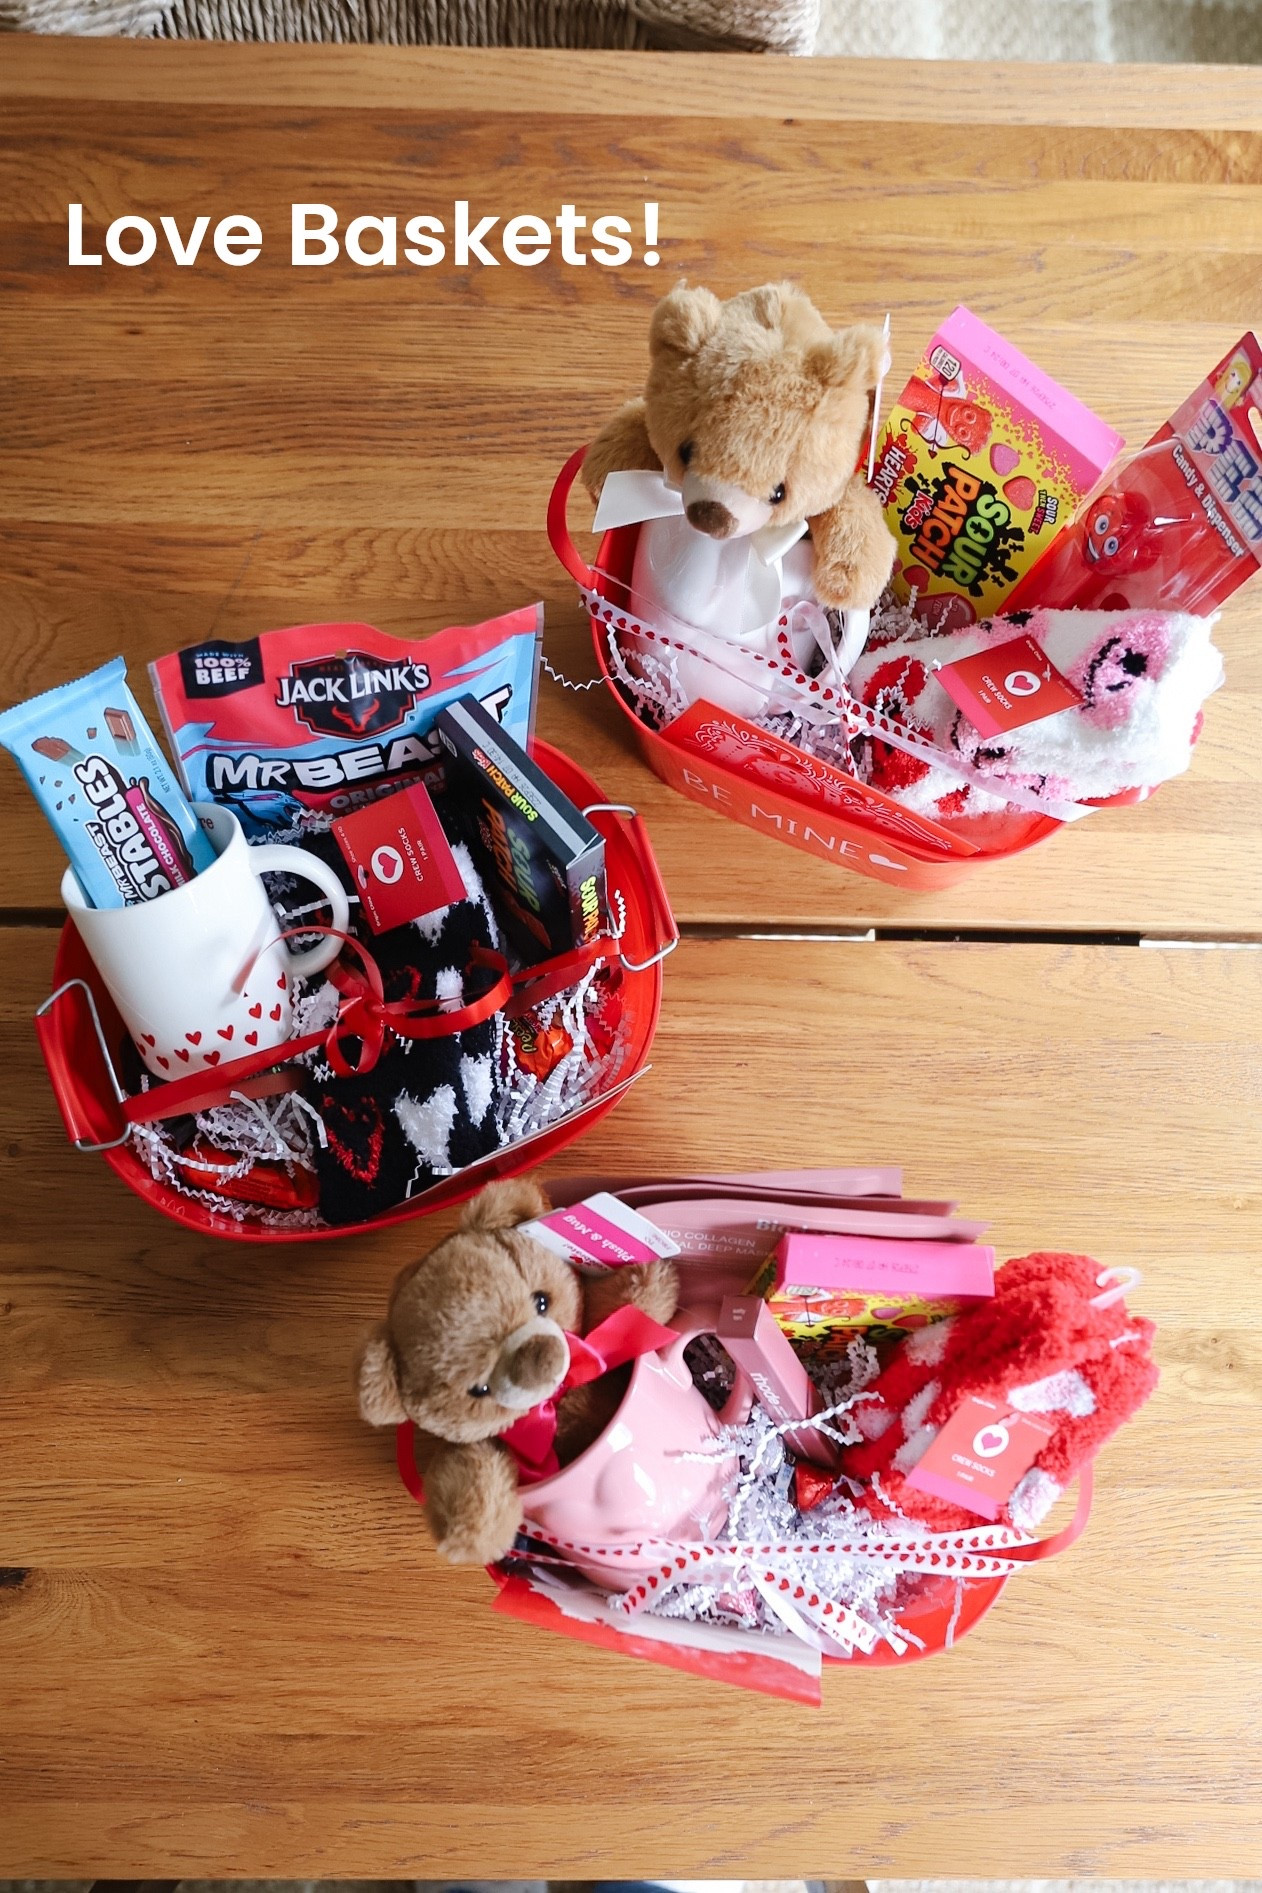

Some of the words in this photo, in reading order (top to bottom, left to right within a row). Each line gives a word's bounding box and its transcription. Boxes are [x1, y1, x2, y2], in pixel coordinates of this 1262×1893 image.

[941, 358, 957, 377] 120
[1185, 399, 1262, 541] PEZ
[904, 490, 934, 530] Kids
[1043, 496, 1058, 525] SOUR
[1173, 444, 1198, 488] Candy
[1194, 483, 1206, 498] &
[1201, 496, 1245, 558] Dispenser
[912, 466, 982, 570] PATCH
[942, 493, 1010, 585] SOUR
[195, 657, 252, 668] 100%
[195, 667, 250, 685] BEEF
[277, 677, 349, 706] JACK
[349, 664, 430, 700] LINK'S
[981, 675, 997, 694] CREW
[994, 690, 1013, 710] SOCKS
[160, 783, 171, 793] NET
[486, 761, 517, 796] PATCH
[510, 789, 540, 822] SOUR
[682, 768, 733, 806] BE
[751, 803, 864, 860] MINE
[136, 802, 174, 867] CHOCOLATE
[398, 827, 415, 857] SOCKS
[416, 840, 427, 857] PAIR
[410, 857, 424, 882] CREW
[507, 828, 541, 912] SOUR
[580, 875, 600, 916] SOUR
[562, 1214, 592, 1235] Mug
[590, 1231, 603, 1241] &
[685, 1230, 757, 1248] COLLAGEN
[602, 1238, 635, 1262] Plush
[698, 1241, 734, 1253] DEEP
[750, 1373, 781, 1405] rhode
